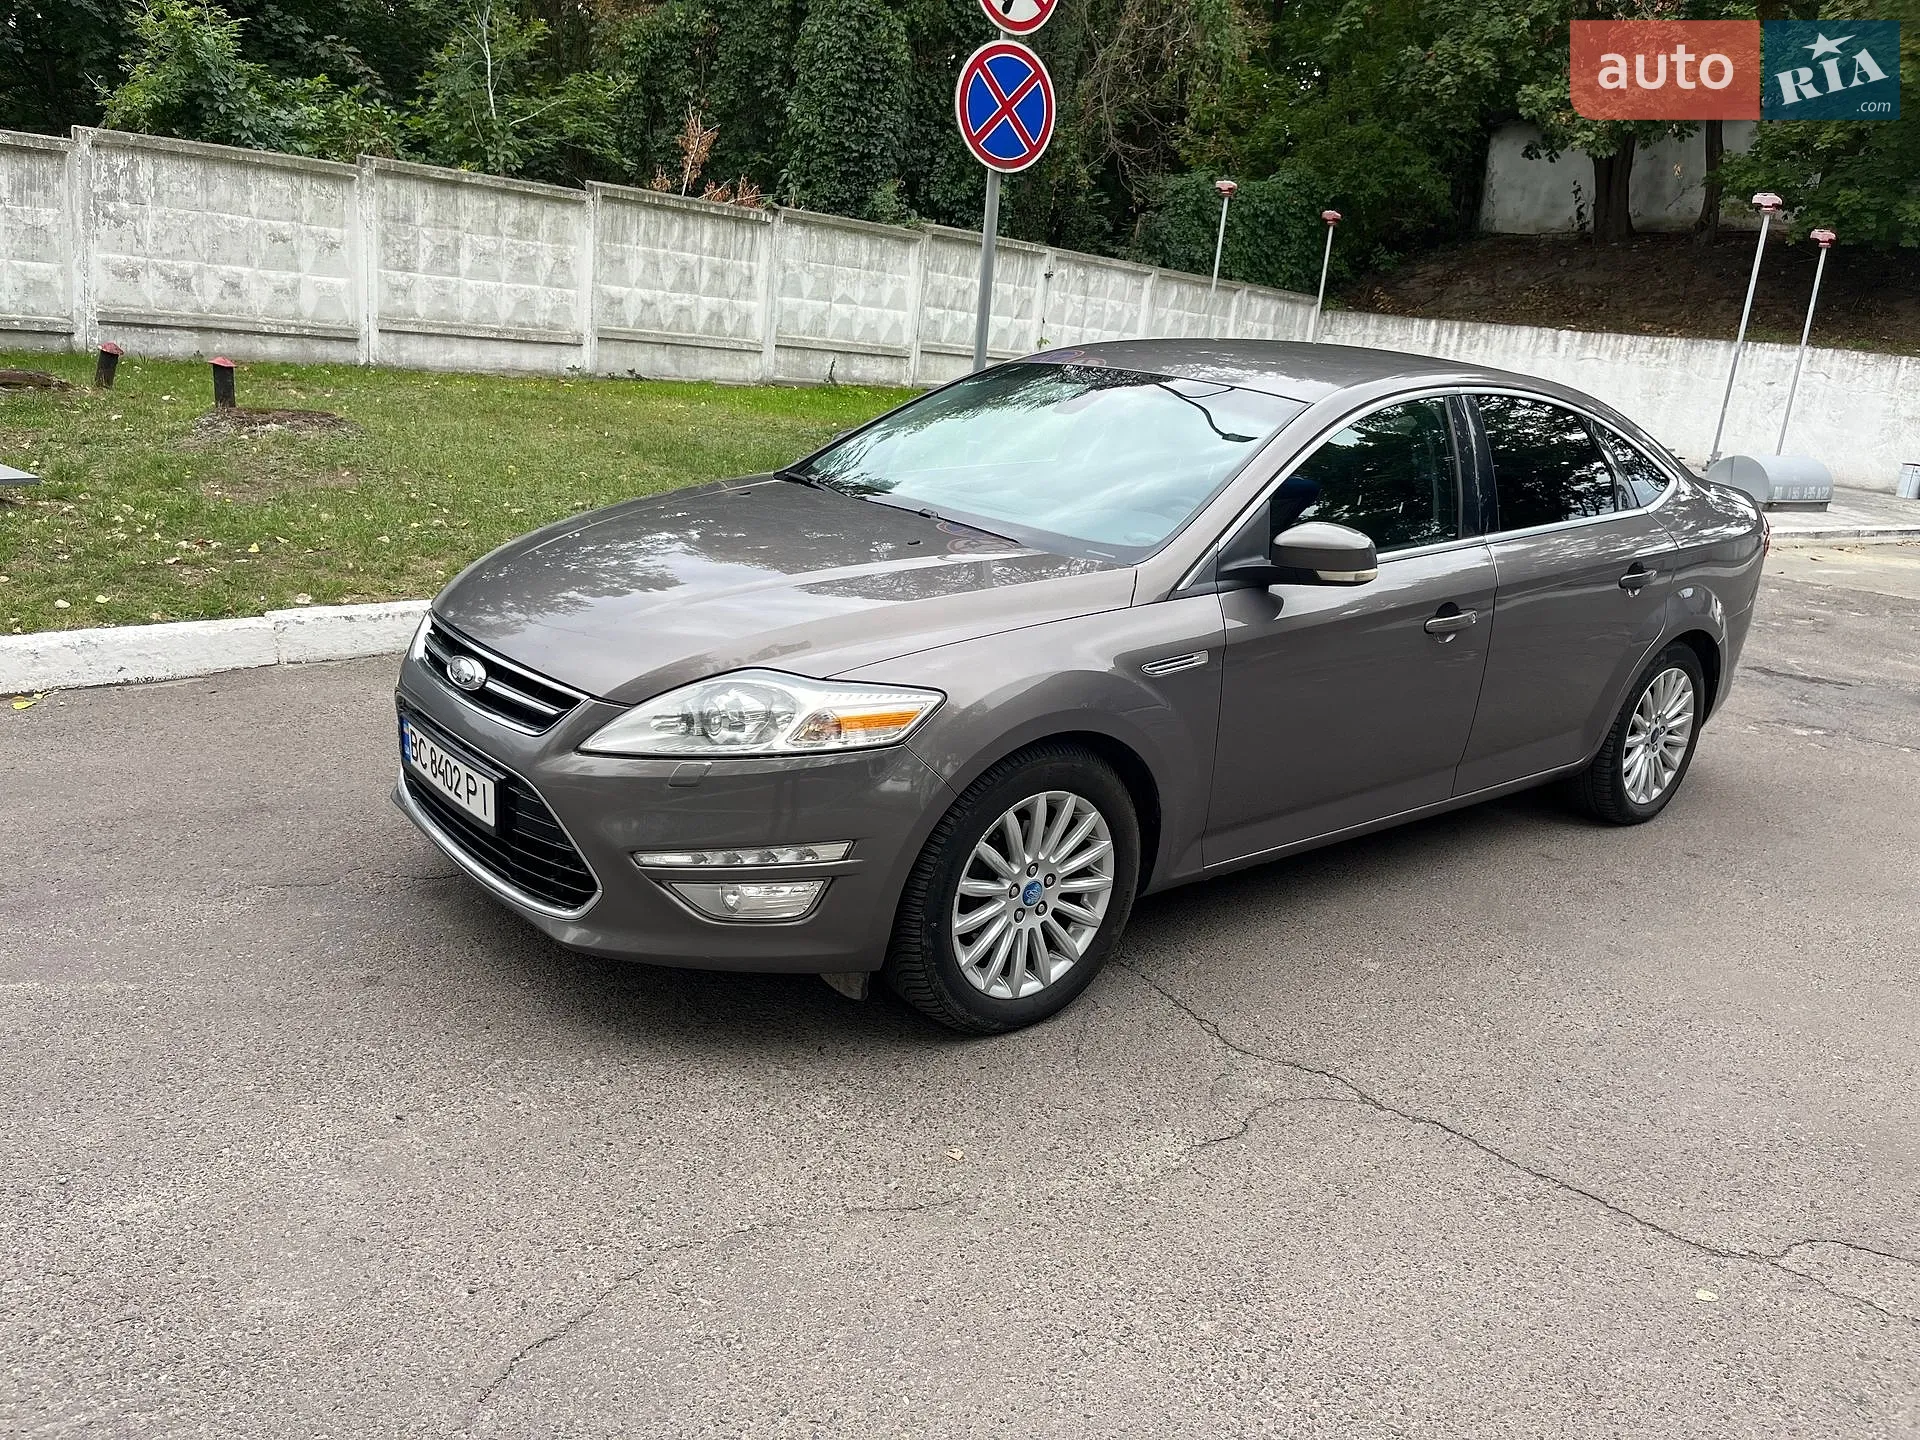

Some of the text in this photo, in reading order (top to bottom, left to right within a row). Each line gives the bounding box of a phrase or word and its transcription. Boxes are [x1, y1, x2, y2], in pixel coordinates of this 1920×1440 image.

[410, 727, 487, 815] BC 8402 PI
